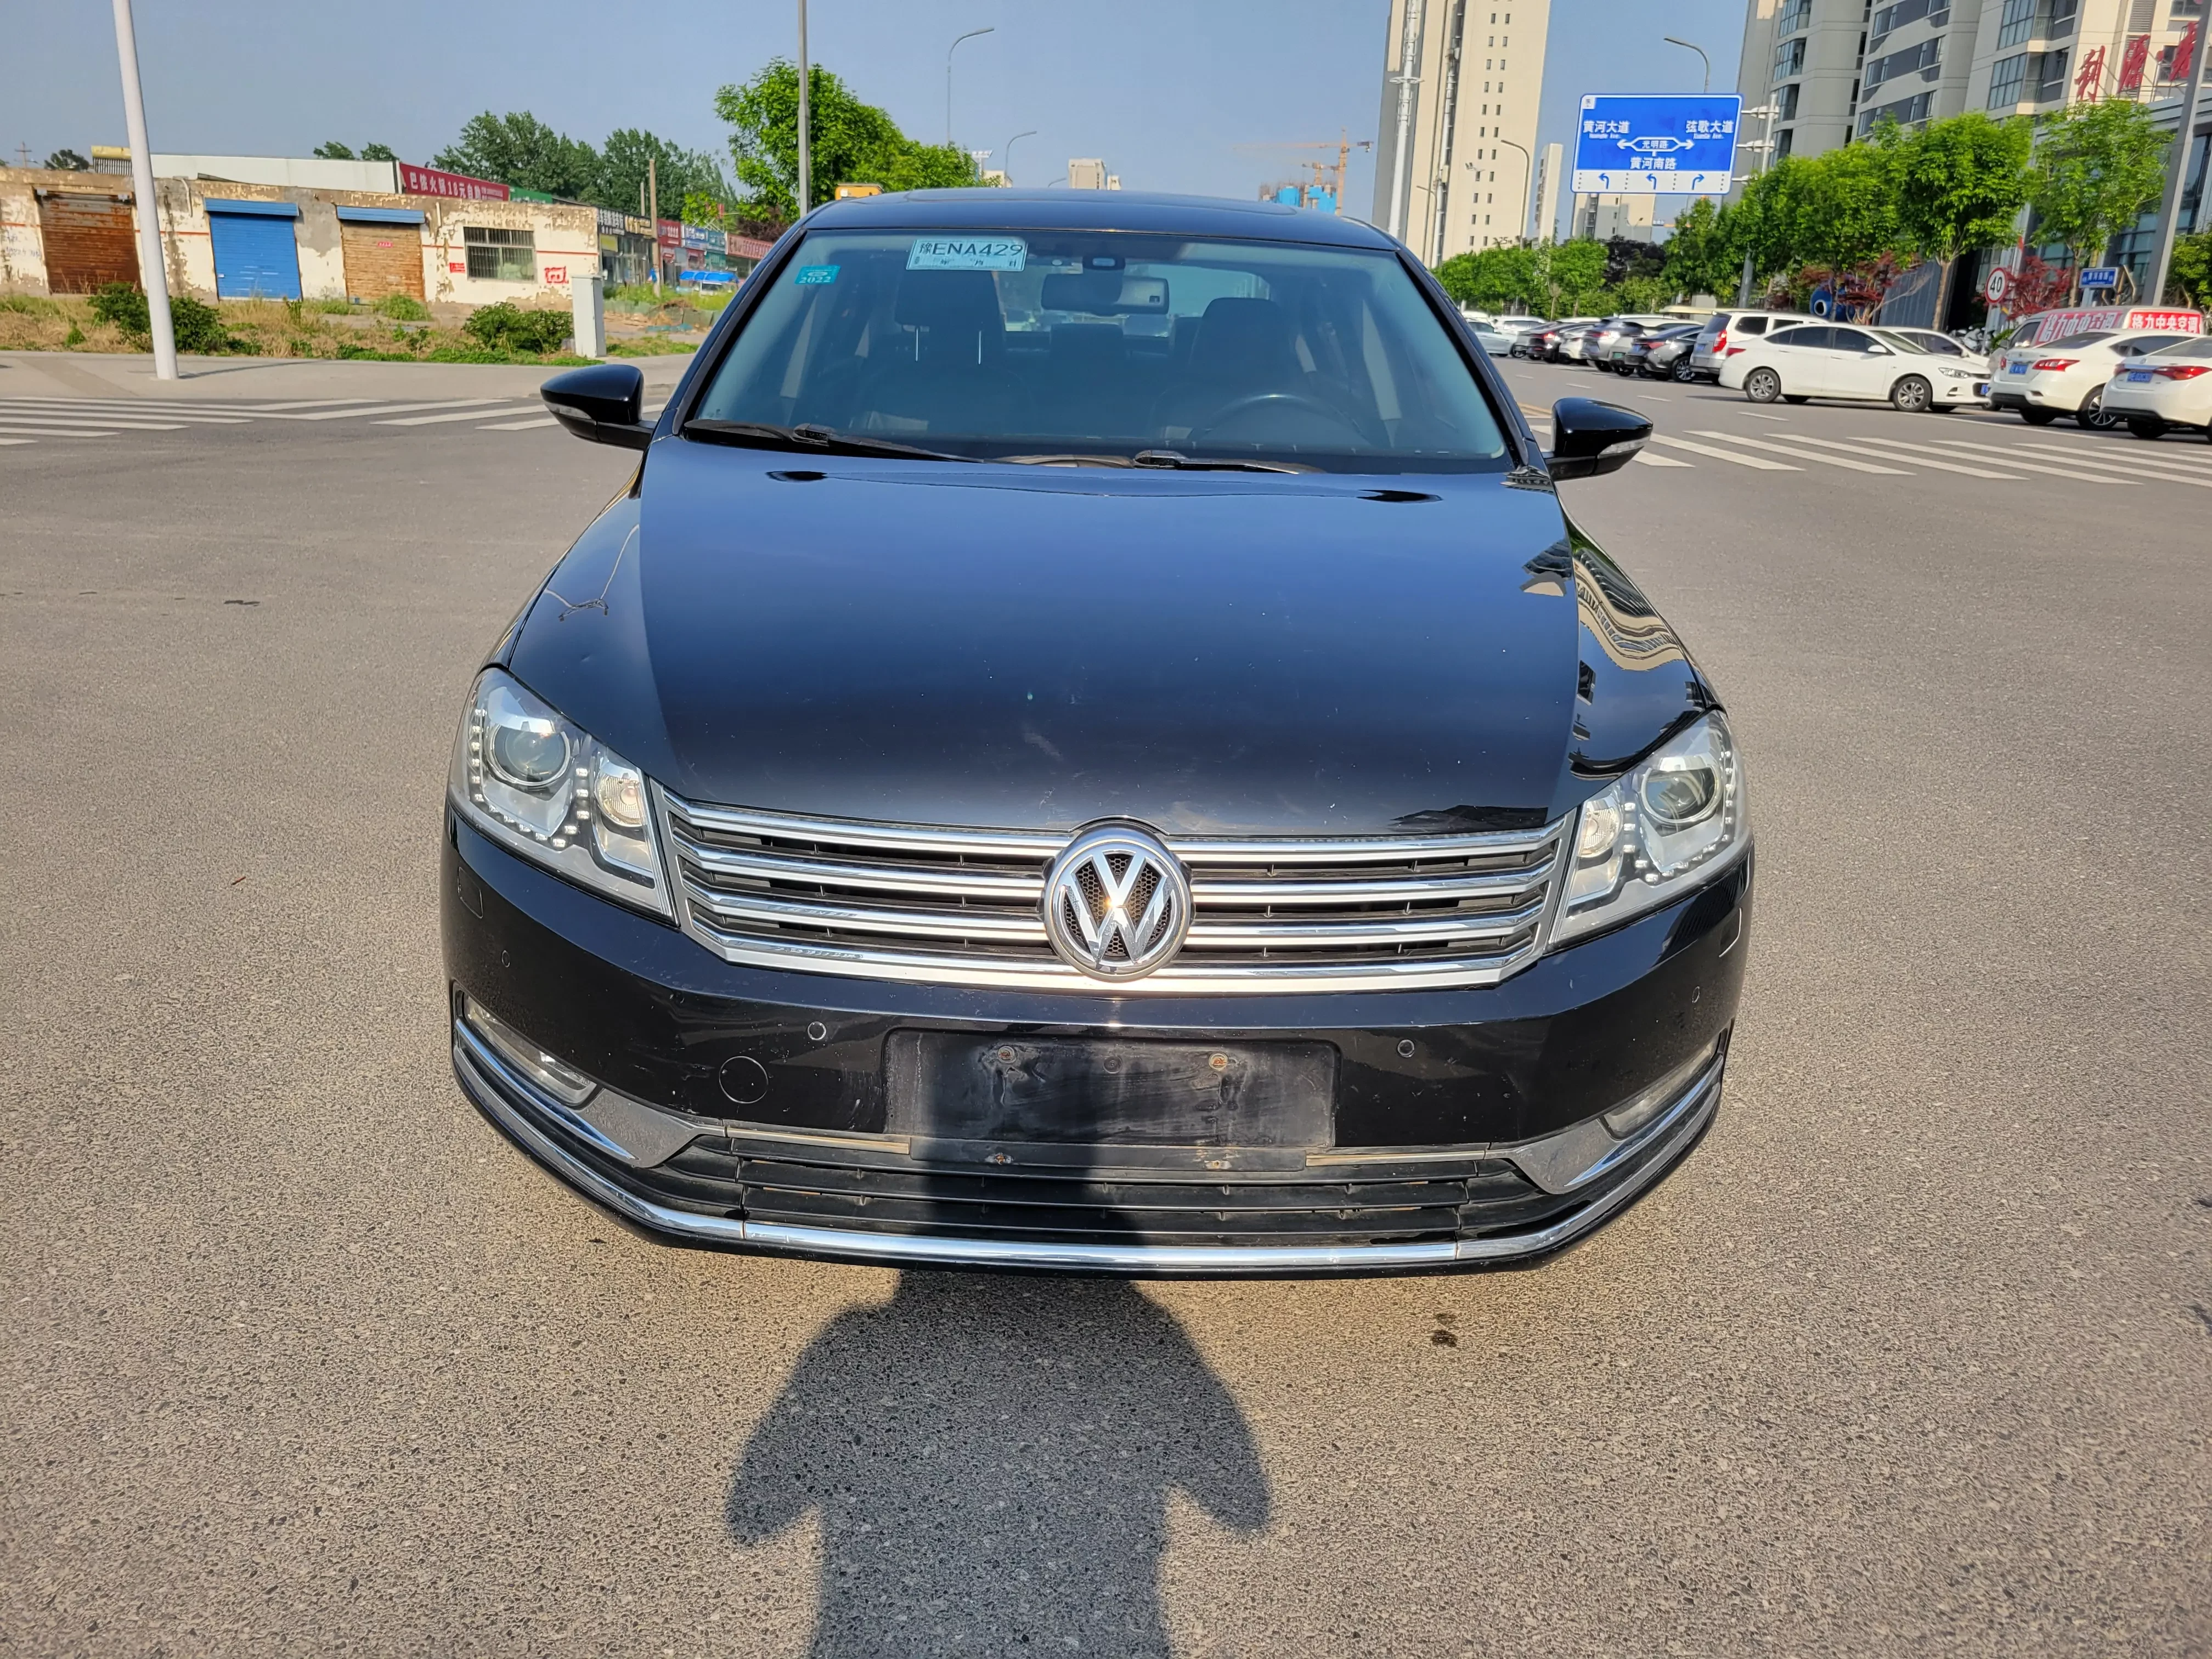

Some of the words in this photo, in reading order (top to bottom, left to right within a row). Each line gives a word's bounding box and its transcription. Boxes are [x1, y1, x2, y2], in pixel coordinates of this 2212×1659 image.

[1583, 120, 1629, 133] 黄河大道
[1686, 120, 1734, 133] 弦歌大道
[1642, 140, 1668, 149] 光明路
[1630, 157, 1676, 170] 黄河南路
[919, 242, 1023, 256] 豫ENA429
[1990, 276, 2002, 293] 40
[2132, 314, 2198, 334] 格力中央空调
